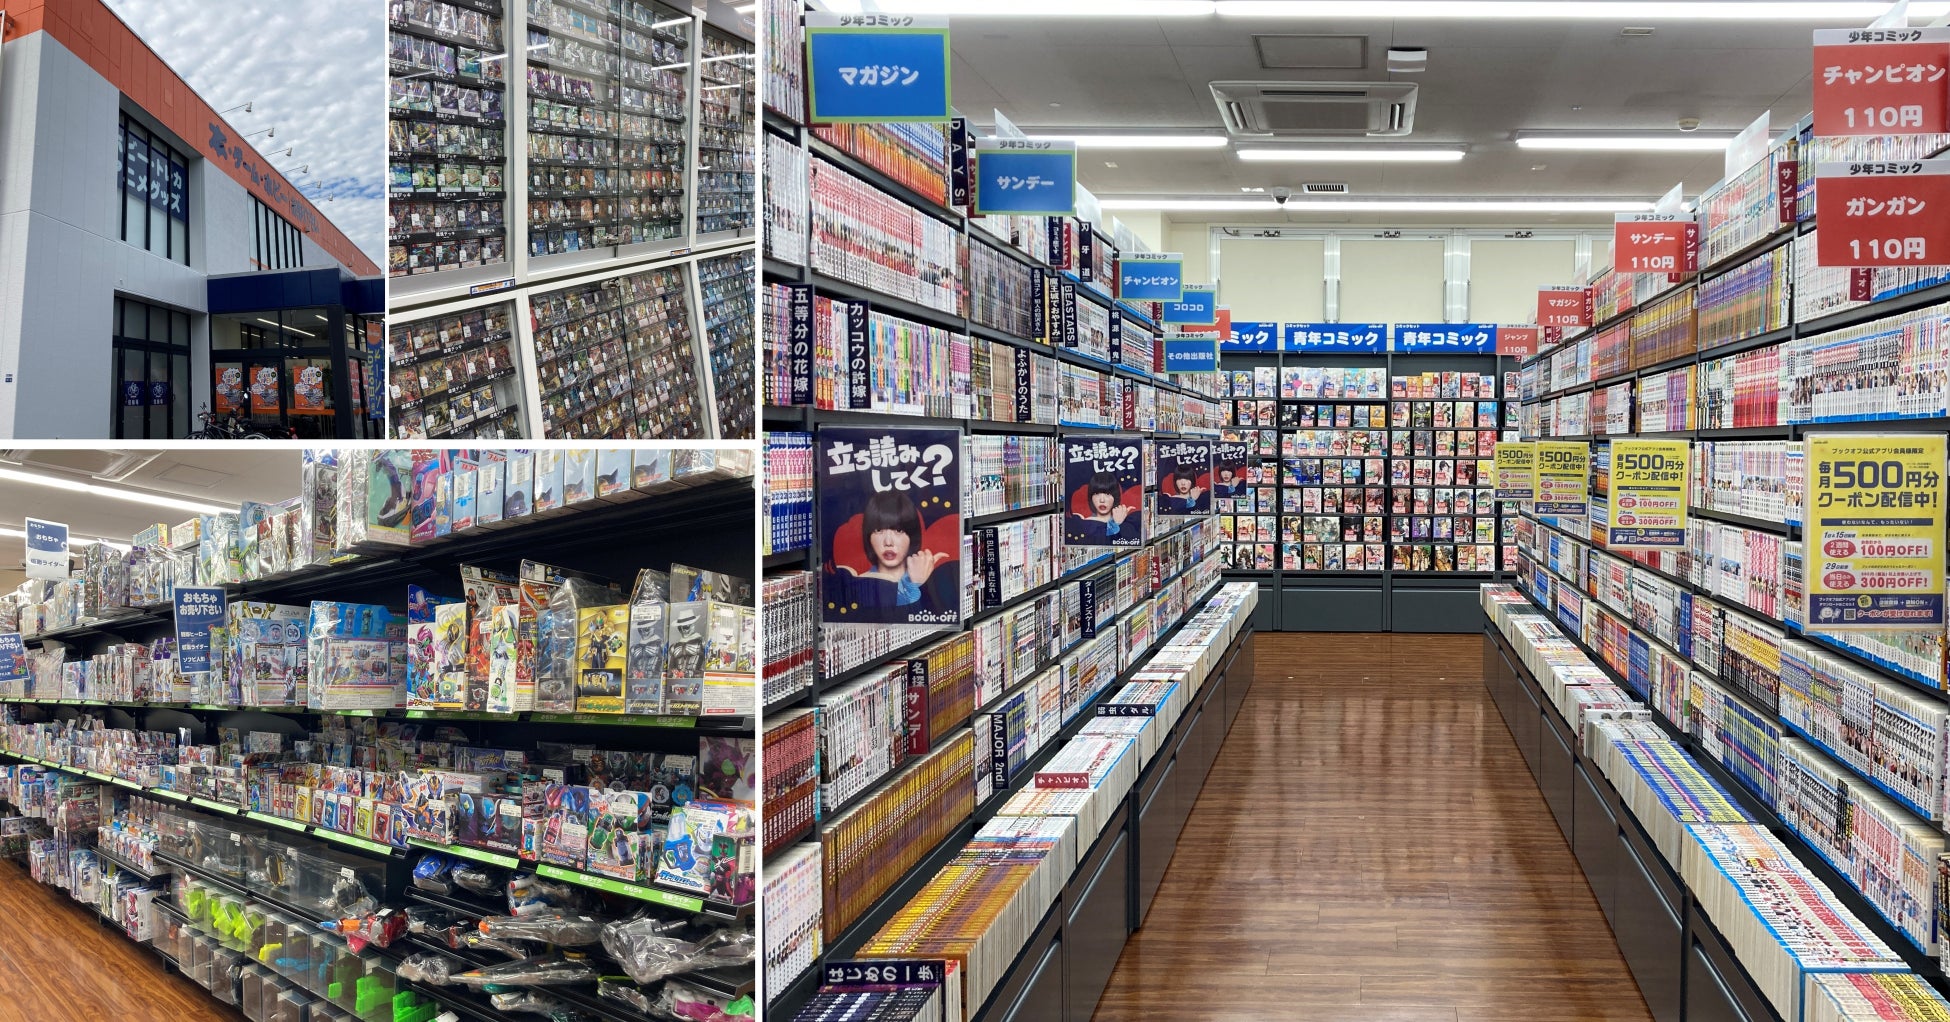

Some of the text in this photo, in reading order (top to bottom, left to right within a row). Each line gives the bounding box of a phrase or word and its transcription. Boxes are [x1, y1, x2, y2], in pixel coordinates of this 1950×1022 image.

[840, 15, 914, 27] 少年コミック
[1848, 30, 1922, 42] 少年コミック
[838, 64, 920, 86] マガジン
[1823, 64, 1946, 85] チャンピオン
[1844, 105, 1923, 128] 110円
[999, 141, 1052, 149] 少年コミック
[1849, 162, 1923, 175] 少年コミック
[996, 175, 1055, 190] サンデー
[1781, 168, 1792, 220] サンデー
[1846, 198, 1926, 217] ガンガン
[1629, 233, 1676, 245] サンデー
[1686, 228, 1696, 269] サンデー
[1850, 238, 1926, 260] 110円
[1631, 256, 1675, 269] 110円
[1123, 276, 1179, 286] チャンピオン
[1173, 303, 1204, 312] コロコロ
[1548, 299, 1580, 307] マガジン
[1064, 285, 1076, 342] BEASTARS
[1549, 315, 1579, 324] 110円
[793, 287, 809, 391] 五等分の花嫁
[1293, 331, 1379, 346] 青年コミック
[1403, 331, 1489, 346] 青年コミック
[851, 303, 867, 398] カッコウの許嫁
[1167, 352, 1214, 361] その他出版社
[1504, 346, 1528, 354] 110円
[1017, 349, 1028, 414] よふかしのうた
[827, 435, 920, 476] 立ち読み
[1068, 441, 1121, 464] 立ち読み
[1159, 443, 1197, 459] 立ち読み
[1176, 445, 1208, 465] してく?
[1092, 446, 1139, 474] してく?
[871, 443, 954, 493] してく?
[1860, 545, 1928, 556] 100円OFF!
[1860, 577, 1928, 588] 300円OFF!
[183, 592, 218, 603] おもちゃ
[180, 604, 222, 616] お売り下さい
[908, 692, 922, 749] サンデー
[993, 714, 1004, 758] MAJOR
[1037, 777, 1088, 785] チャンピオン
[828, 965, 934, 983] はじめの一歩
